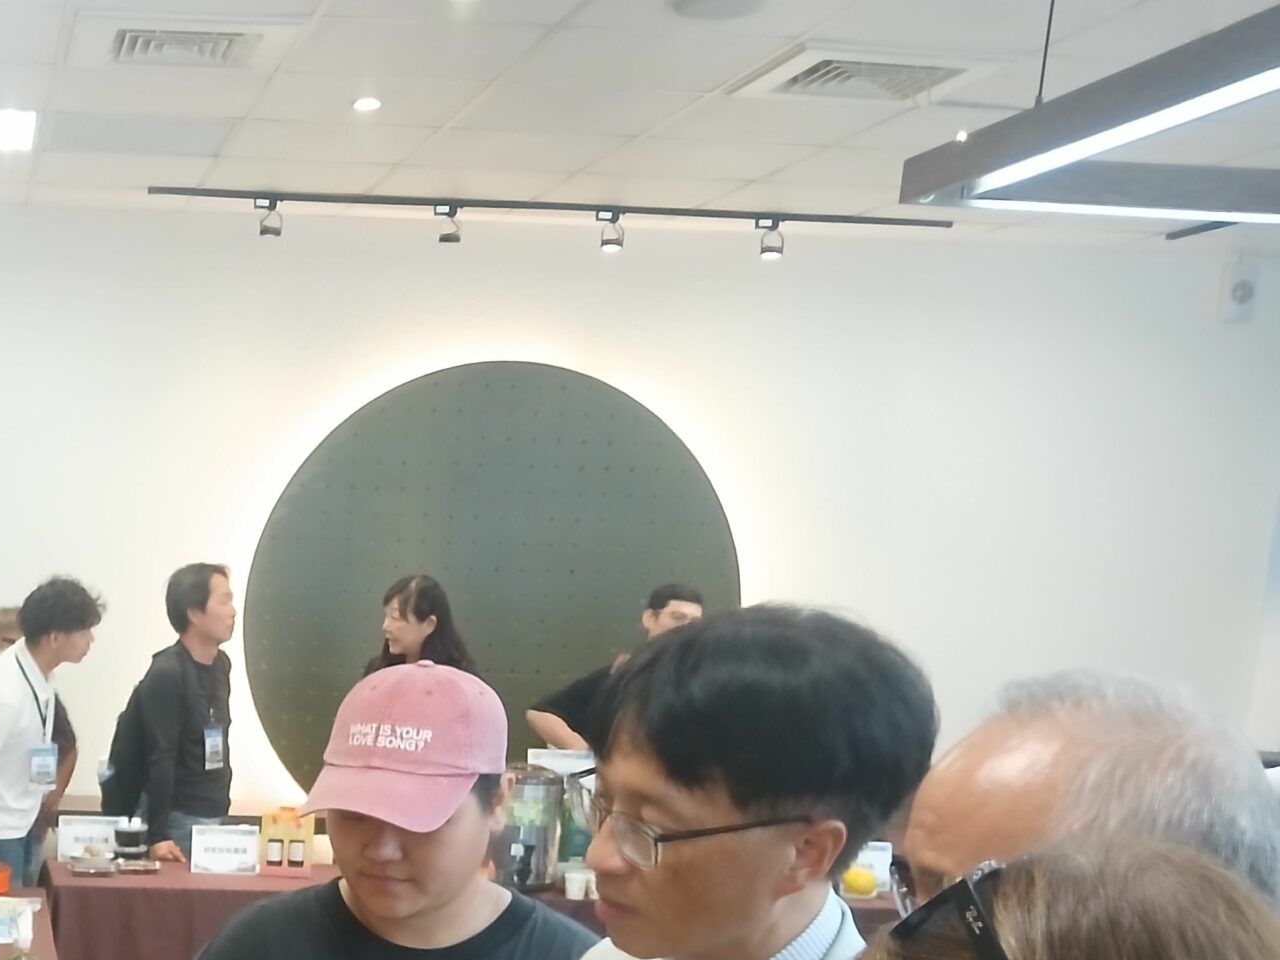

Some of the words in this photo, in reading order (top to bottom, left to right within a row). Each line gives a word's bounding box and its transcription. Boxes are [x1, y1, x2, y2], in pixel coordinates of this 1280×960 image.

[349, 722, 377, 735] WHAT
[379, 724, 392, 736] IS
[395, 725, 433, 742] YOUR
[349, 734, 375, 746] LOVE
[376, 735, 425, 752] SONG?
